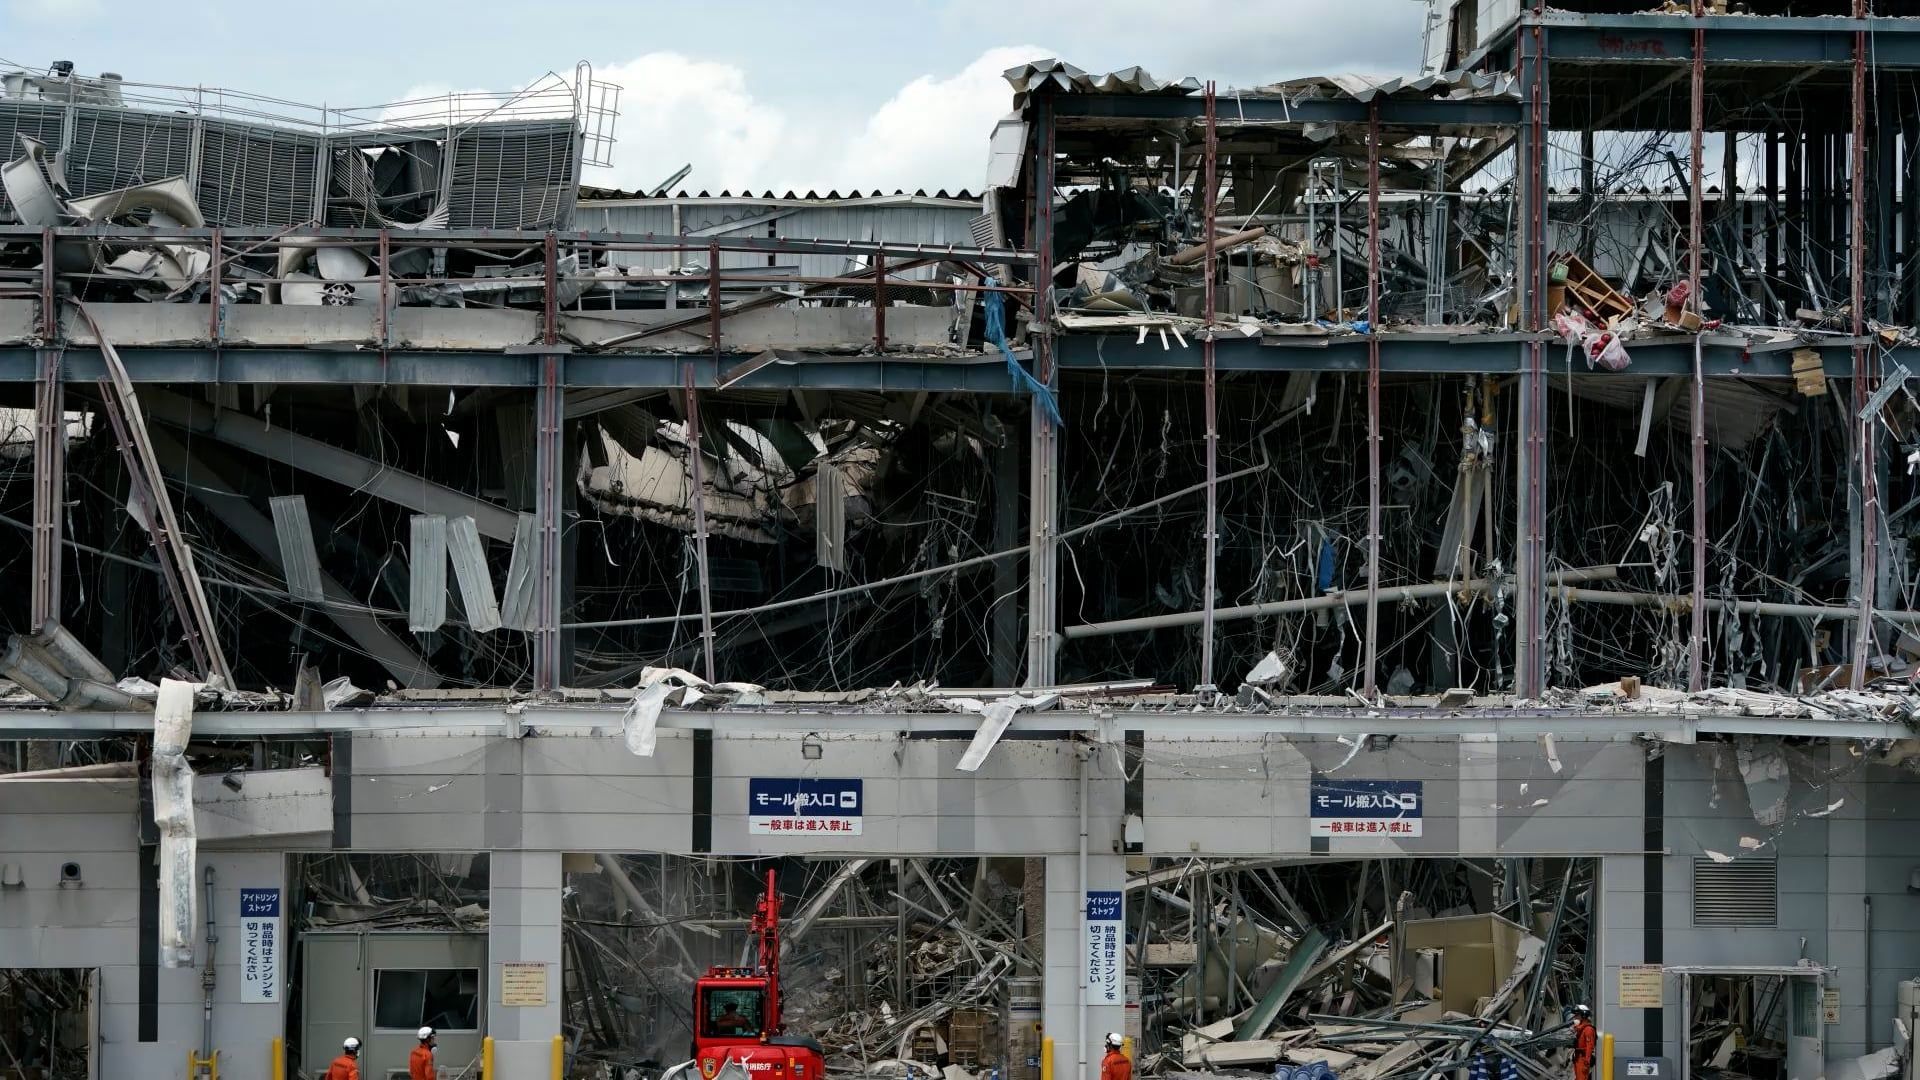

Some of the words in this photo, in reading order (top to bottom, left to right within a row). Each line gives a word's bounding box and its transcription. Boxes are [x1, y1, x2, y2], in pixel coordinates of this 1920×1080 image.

[1317, 795, 1395, 809] モール搬入口
[758, 819, 853, 832] 一般車は進入禁止
[1319, 821, 1413, 833] 一般車は進入禁止
[242, 893, 278, 902] アイドリング
[1086, 897, 1120, 906] アイドリング
[248, 904, 272, 912] ストップ
[1091, 907, 1115, 915] ストップ
[246, 922, 258, 981] 切ってください
[1089, 925, 1101, 983] 切ってください
[262, 922, 274, 998] 納品時はエンジンを
[1104, 925, 1116, 1000] 納品時はエンジンを
[745, 1063, 772, 1071] 消防庁
